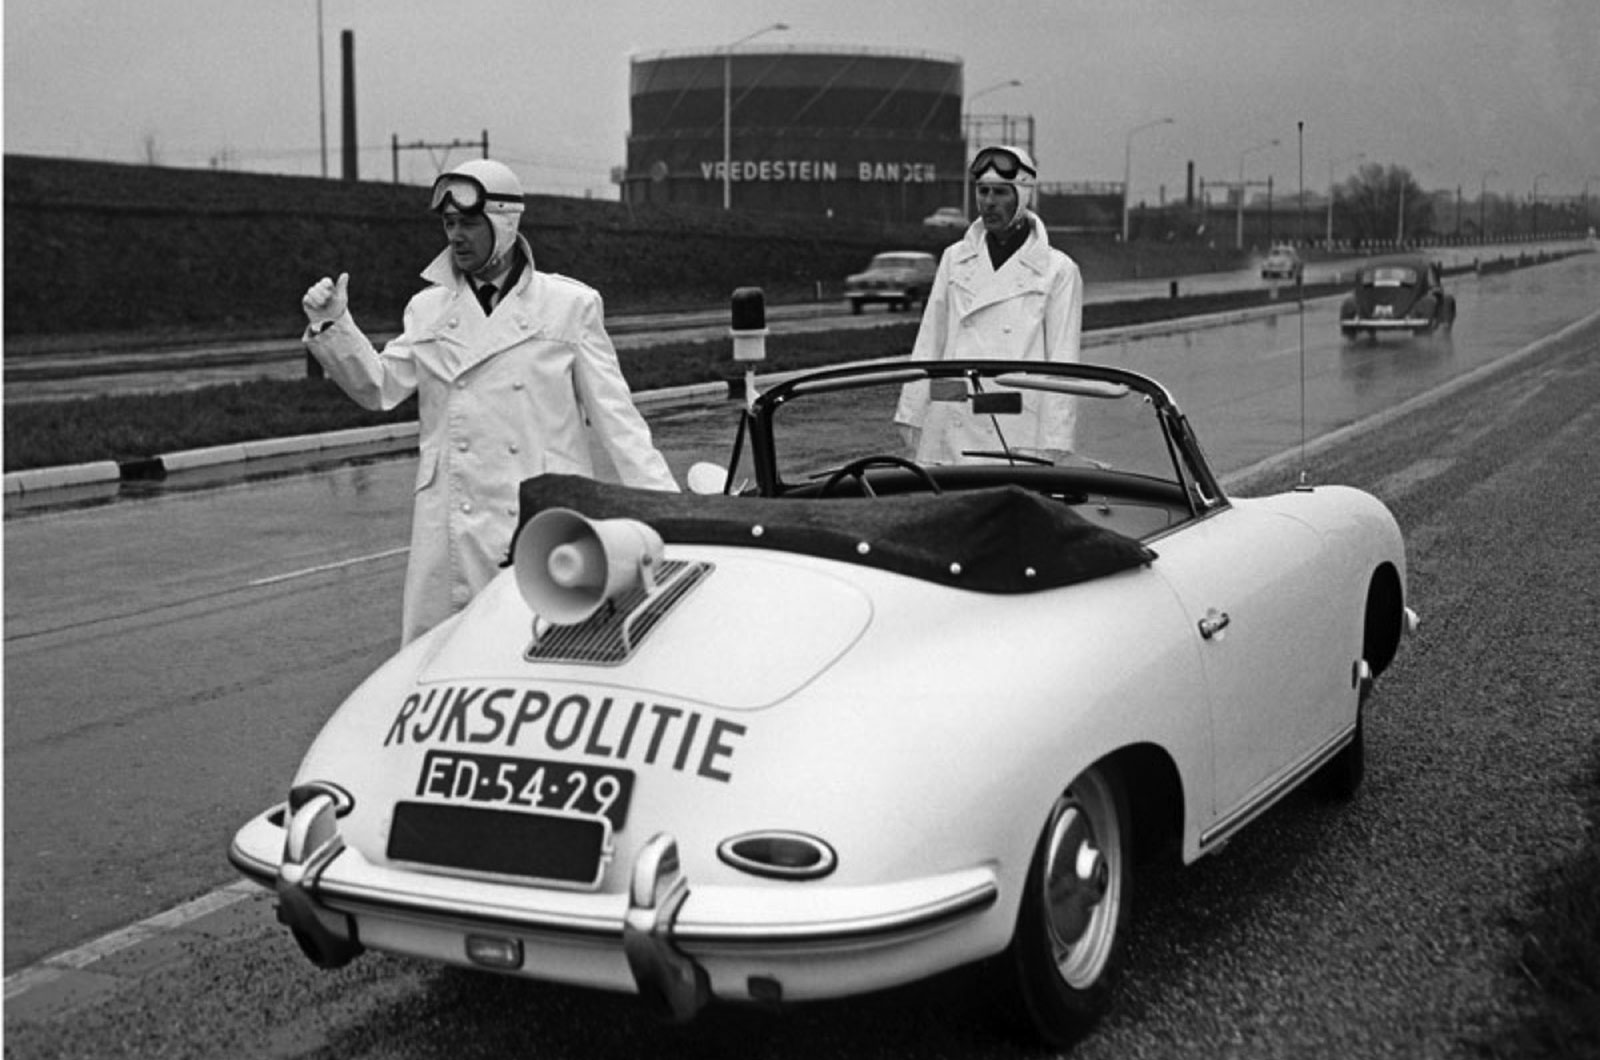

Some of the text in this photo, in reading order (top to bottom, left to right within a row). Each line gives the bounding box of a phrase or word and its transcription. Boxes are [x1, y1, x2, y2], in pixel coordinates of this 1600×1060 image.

[701, 160, 936, 182] VREDESTEIN BANDEN
[383, 687, 747, 783] RIJKSPOLITIE
